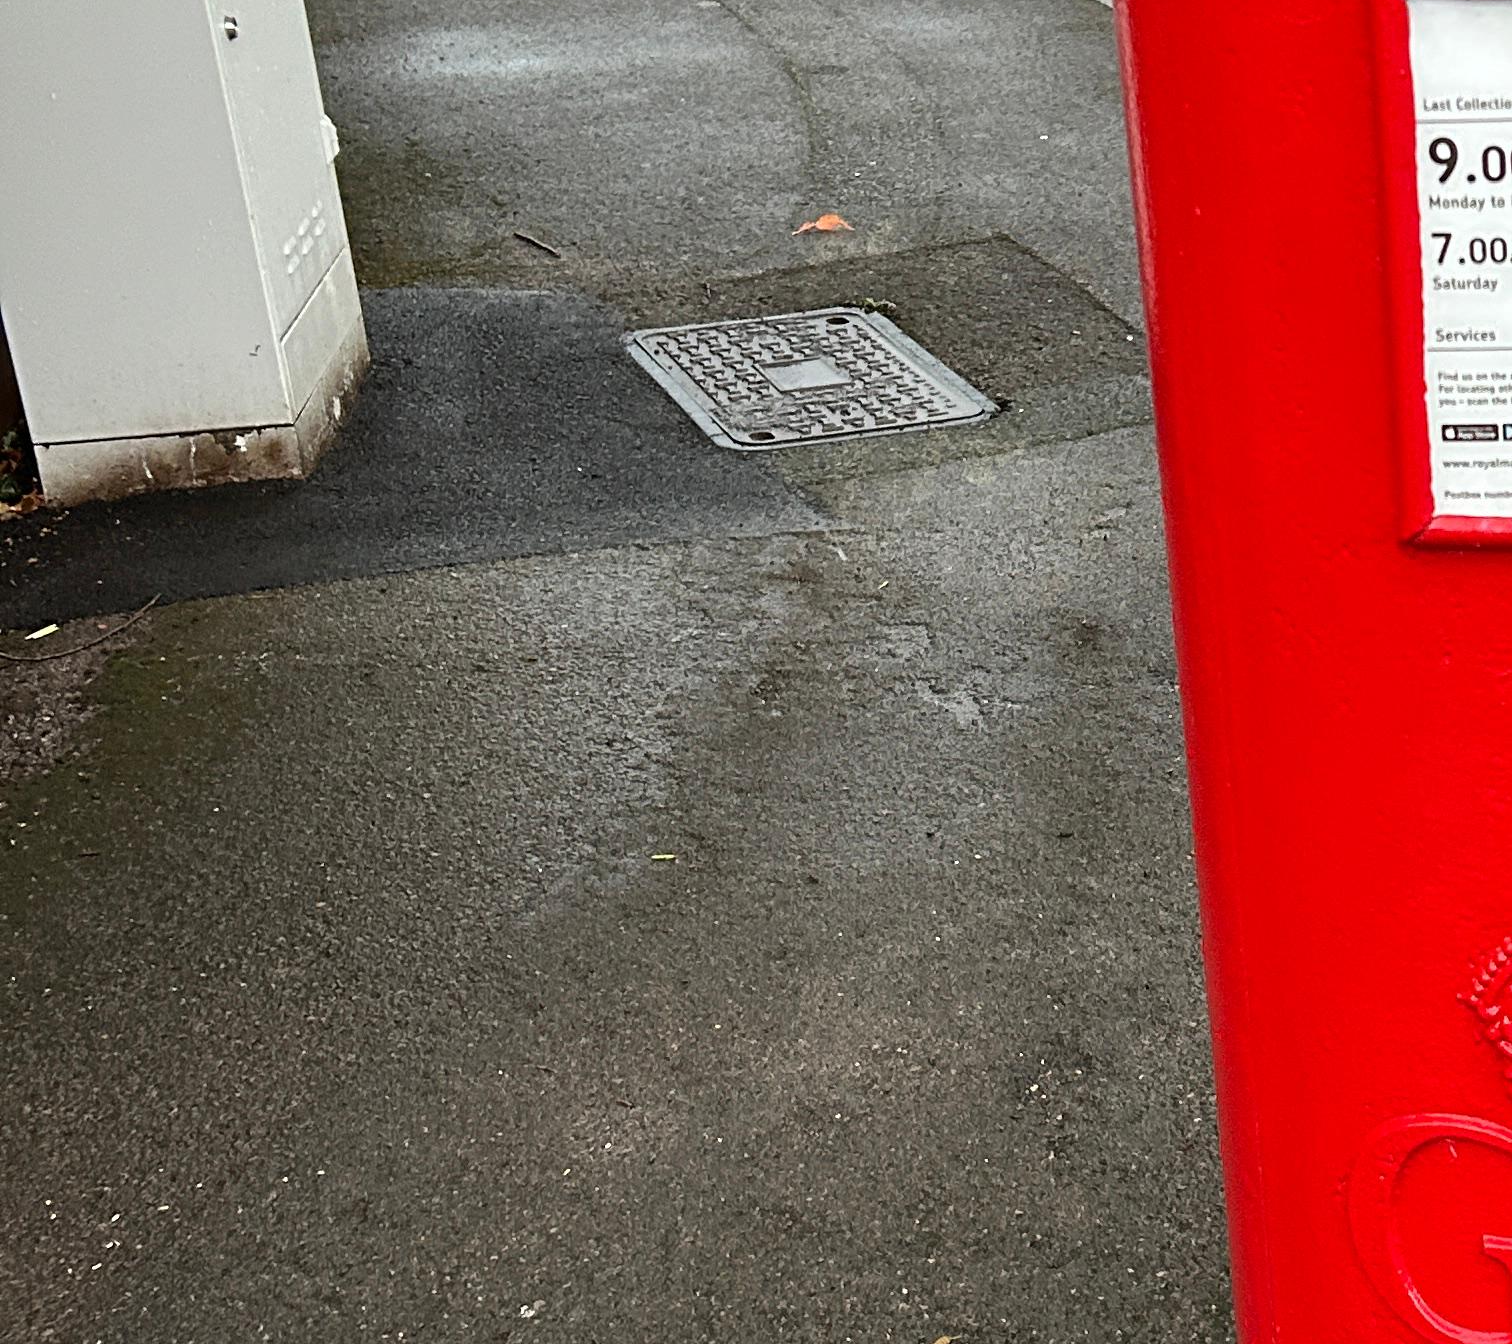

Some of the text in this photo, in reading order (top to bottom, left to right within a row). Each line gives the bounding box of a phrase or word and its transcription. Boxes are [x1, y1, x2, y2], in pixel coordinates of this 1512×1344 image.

[1423, 97, 1452, 112] Last
[1428, 194, 1485, 211] Monday
[1491, 194, 1505, 208] to
[1433, 275, 1498, 292] Saturday
[1435, 327, 1497, 342] Services
[1438, 370, 1458, 381] Find
[1491, 370, 1506, 381] the
[1438, 385, 1454, 393] For
[1457, 384, 1495, 394] locating
[1439, 397, 1456, 408] you
[1467, 397, 1489, 406] scan
[1491, 397, 1507, 406] the
